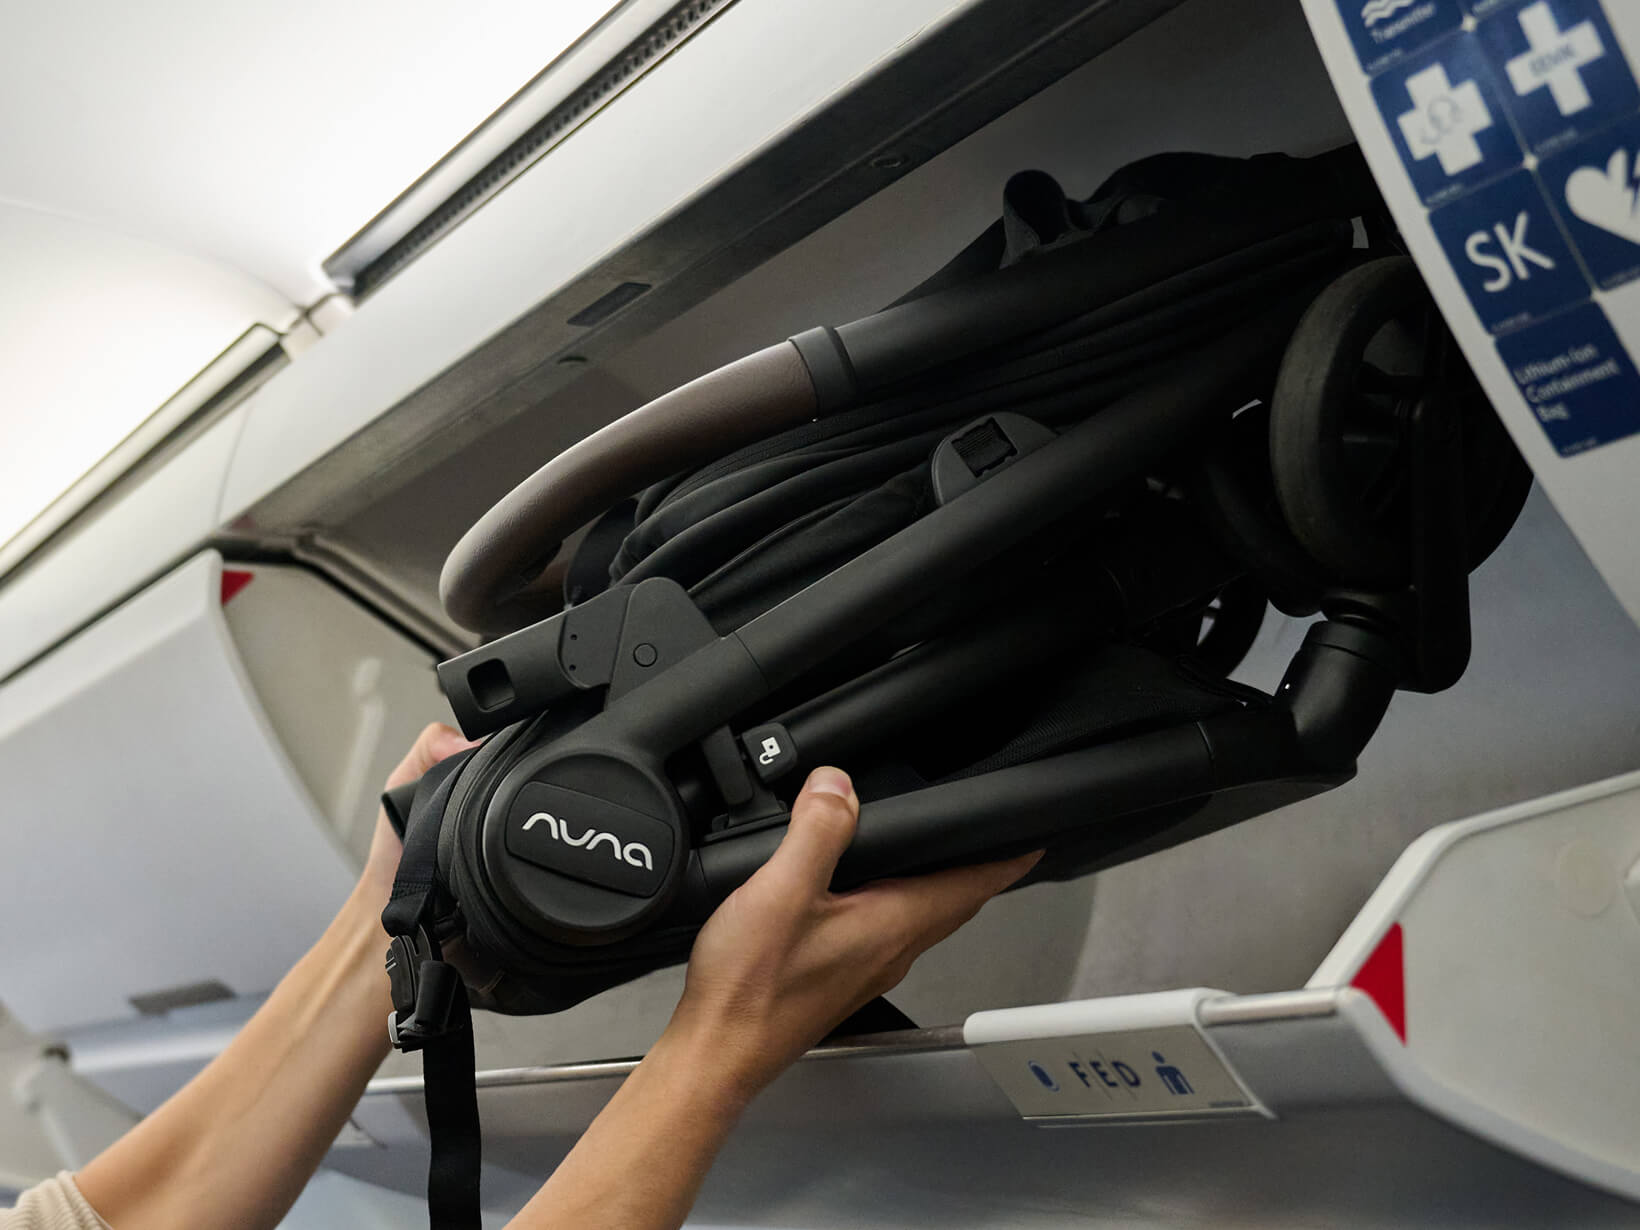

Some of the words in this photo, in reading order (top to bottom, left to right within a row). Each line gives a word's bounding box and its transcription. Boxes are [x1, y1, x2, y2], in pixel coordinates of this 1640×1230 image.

[1465, 211, 1555, 292] SK
[1525, 358, 1619, 404] Containment
[1536, 402, 1570, 422] Bag
[522, 812, 653, 871] nuna
